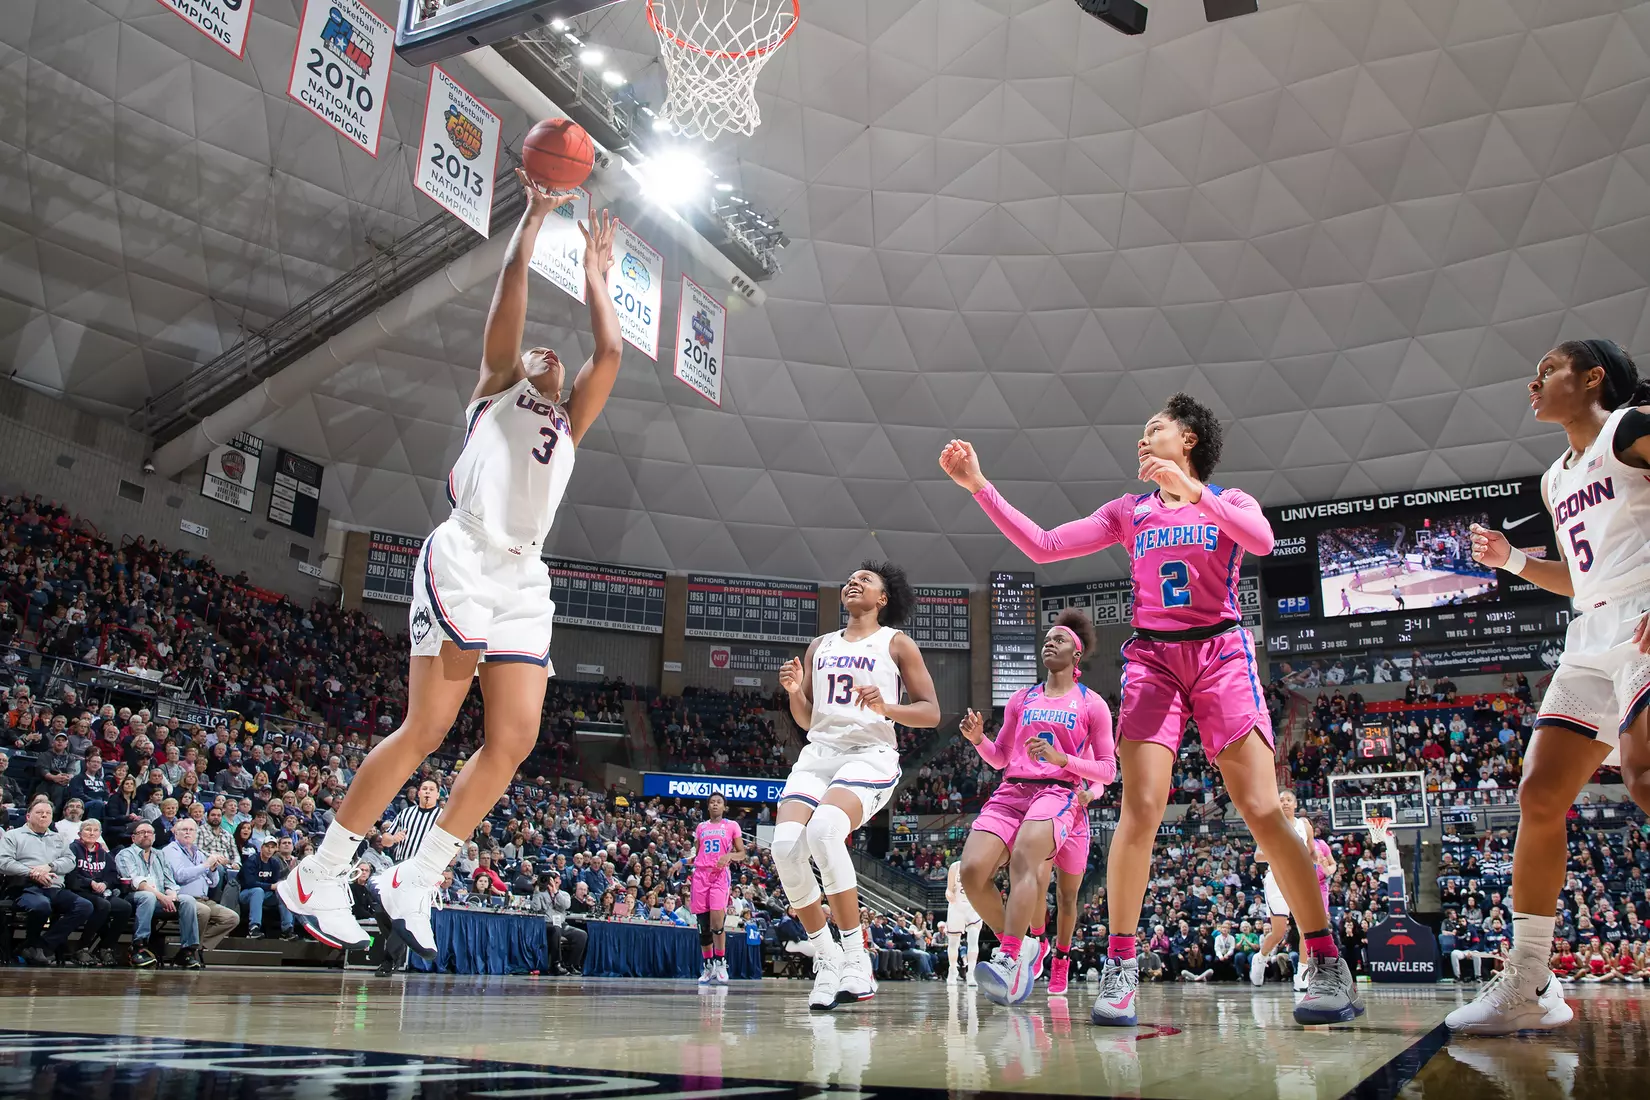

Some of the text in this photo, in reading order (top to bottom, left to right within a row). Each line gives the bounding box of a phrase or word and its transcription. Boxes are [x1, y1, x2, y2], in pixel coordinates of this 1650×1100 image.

[307, 48, 373, 112] 2010
[308, 78, 366, 128] NATIONAL
[439, 72, 495, 124] UConn Women's
[448, 92, 484, 126] Basketball
[300, 90, 368, 144] CHAMPIONS
[430, 143, 484, 197] 2013
[431, 169, 479, 211] NATIONAL
[425, 181, 481, 226] CHAMPIONS
[614, 284, 651, 325] 2015
[620, 325, 651, 352] AMPIONS
[684, 338, 717, 376] 2016
[684, 360, 714, 387] NATIONAL
[681, 370, 716, 399] CHAMPIONS
[532, 427, 558, 464] 3
[1281, 482, 1522, 521] UNIVERSITY OF CONNECTICUT
[196, 526, 208, 536] 211
[374, 534, 392, 543] BIG
[372, 543, 413, 554] REGULAR
[1134, 525, 1219, 560] MEMPHIS
[1273, 536, 1306, 547] WELLS
[1568, 521, 1594, 572] 5
[1273, 546, 1306, 556] FARGO
[392, 554, 407, 565] 1994
[310, 567, 322, 576] 212
[368, 565, 385, 576] 2003
[389, 568, 406, 578] 2005
[550, 569, 653, 585] OURNAMENT CHAMPIONS
[569, 563, 598, 571] AMERICAN
[600, 566, 626, 575] ATHLETIC
[628, 570, 663, 579] CONFERENCE
[592, 581, 606, 591] 1999
[610, 583, 625, 593] 2002
[629, 585, 644, 596] 2004
[648, 588, 663, 598] 2011
[724, 587, 783, 596] APPEARANCES
[1159, 560, 1192, 608] 2
[690, 592, 704, 601] 1955
[709, 593, 723, 602] 1974
[728, 595, 741, 604] 1975
[1238, 592, 1257, 605] 42
[1278, 597, 1307, 608] CBS
[708, 606, 722, 615] 1993
[727, 608, 740, 617] 1997
[745, 609, 759, 618] 2001
[764, 610, 778, 619] 2010
[782, 612, 796, 621] 2015
[1098, 606, 1116, 619] 22
[1556, 611, 1569, 625] 17
[612, 622, 658, 632] BASKETBALL
[1404, 618, 1430, 631] 3:41
[1506, 625, 1512, 634] 3
[1271, 635, 1289, 650] 45
[1425, 652, 1442, 660] Harry
[1452, 650, 1476, 658] Gampel
[1434, 657, 1466, 666] Basketball
[1468, 656, 1490, 664] Capital
[817, 656, 876, 672] UCONN
[827, 674, 853, 704] 13
[187, 714, 202, 723] SEC
[1022, 709, 1077, 730] MEMPHIS
[1365, 727, 1389, 738] 3:41
[1363, 738, 1388, 757] 27
[713, 783, 757, 798] NEWS
[1460, 814, 1478, 822] 116
[704, 840, 720, 853] 35
[1370, 962, 1434, 972] TRAVELERS
